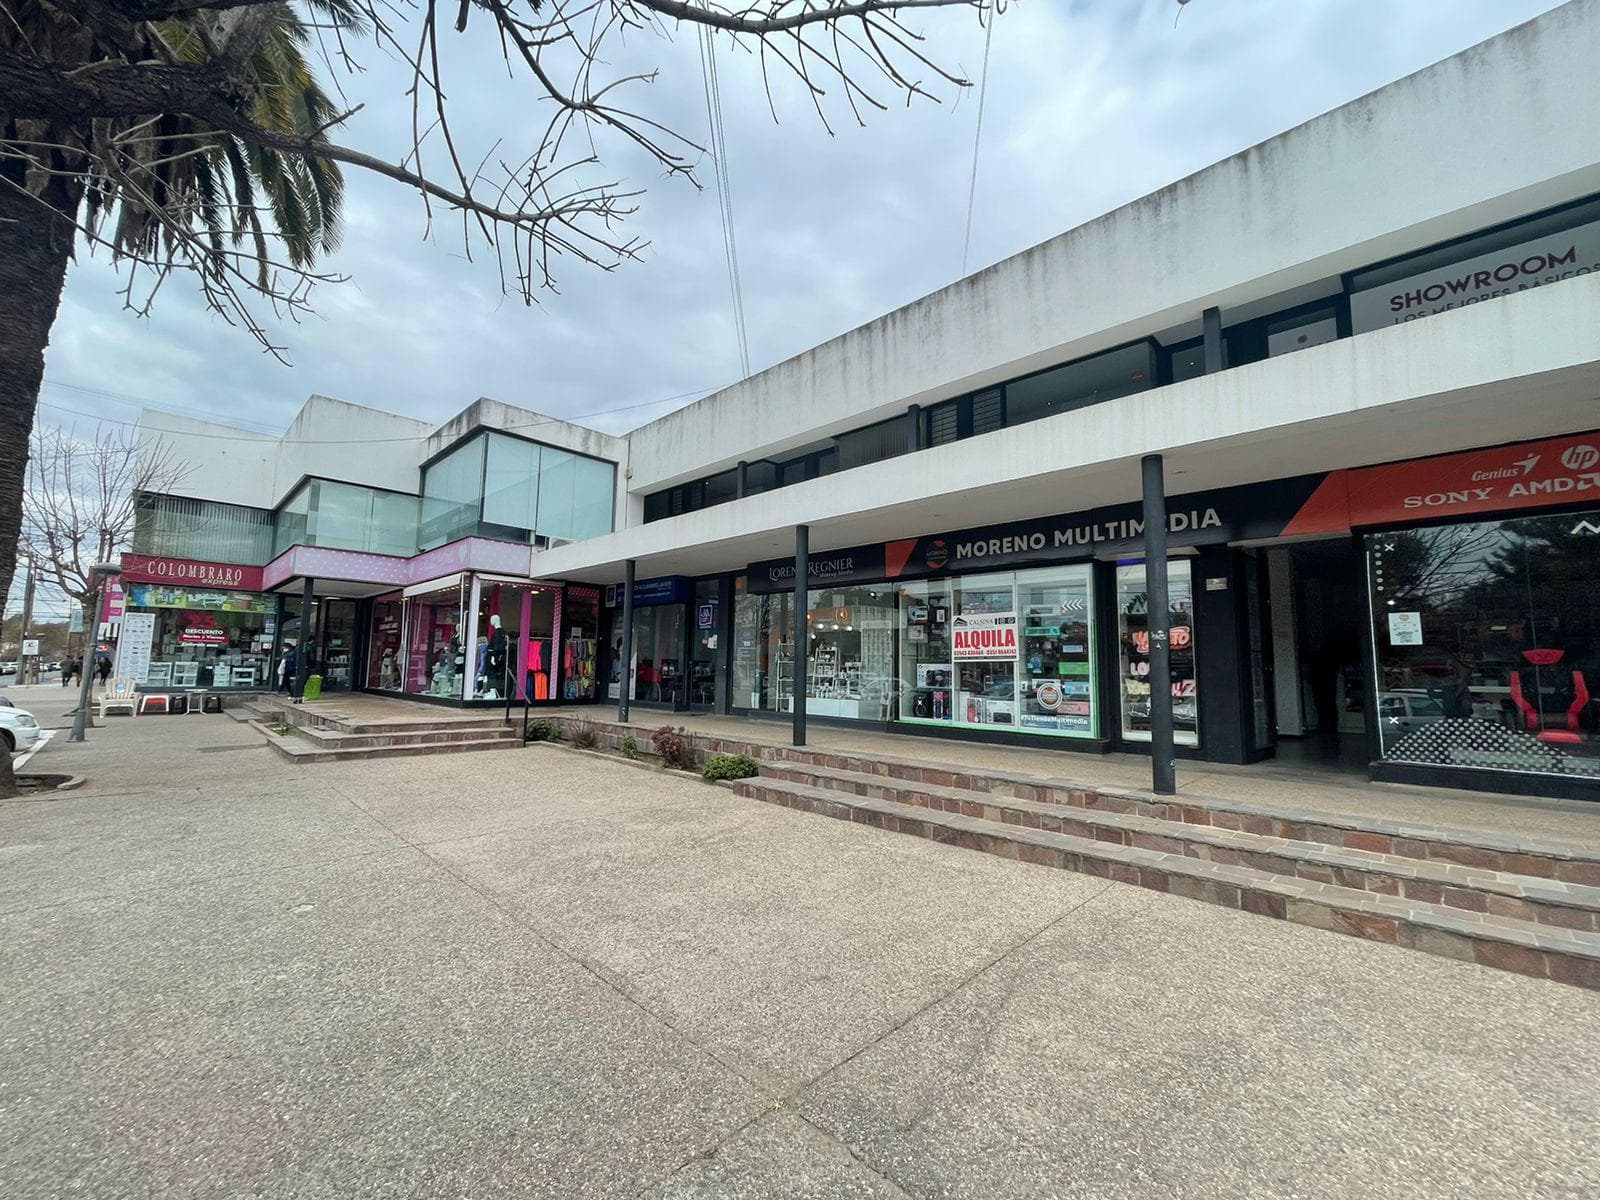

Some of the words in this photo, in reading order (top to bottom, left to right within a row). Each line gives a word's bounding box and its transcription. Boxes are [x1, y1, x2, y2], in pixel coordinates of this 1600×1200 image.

[1390, 245, 1576, 311] SHOWROOM
[1472, 467, 1519, 481] Genius
[1404, 487, 1495, 508] SONY
[1508, 477, 1575, 498] AMD
[956, 532, 1046, 559] MORENO
[1054, 508, 1222, 547] MULTIMDIA
[147, 561, 242, 581] COLOMBRARO
[769, 567, 798, 581] LOREN
[808, 557, 854, 576] REGNIER
[201, 578, 239, 586] express
[954, 628, 1016, 649] ALQUILA
